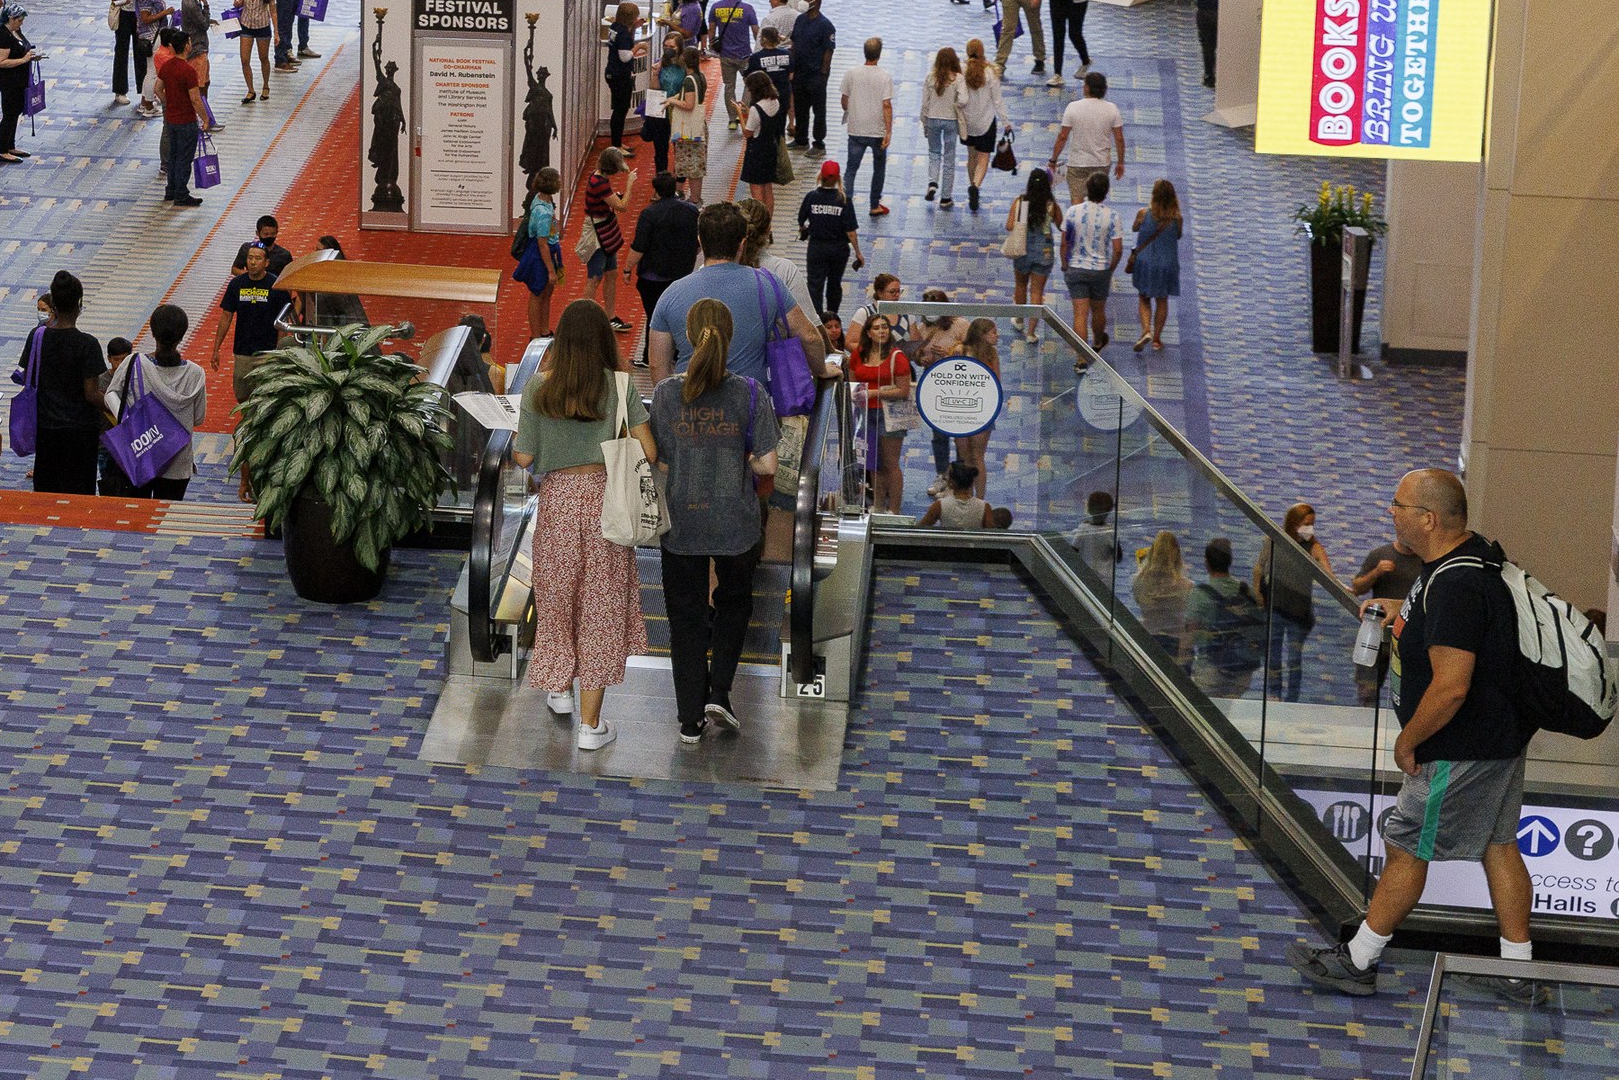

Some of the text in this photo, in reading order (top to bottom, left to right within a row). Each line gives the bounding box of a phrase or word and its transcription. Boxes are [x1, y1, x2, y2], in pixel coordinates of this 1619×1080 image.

[425, 0, 502, 15] FESTIVAL
[418, 14, 509, 30] SPONSORS
[1364, 34, 1395, 142] BRING
[811, 204, 843, 216] SECURITY
[955, 363, 966, 371] DC
[934, 379, 986, 387] CONFIDENCE
[681, 407, 724, 421] HIGH
[1531, 873, 1597, 891] ccess
[1534, 893, 1597, 914] Halls
